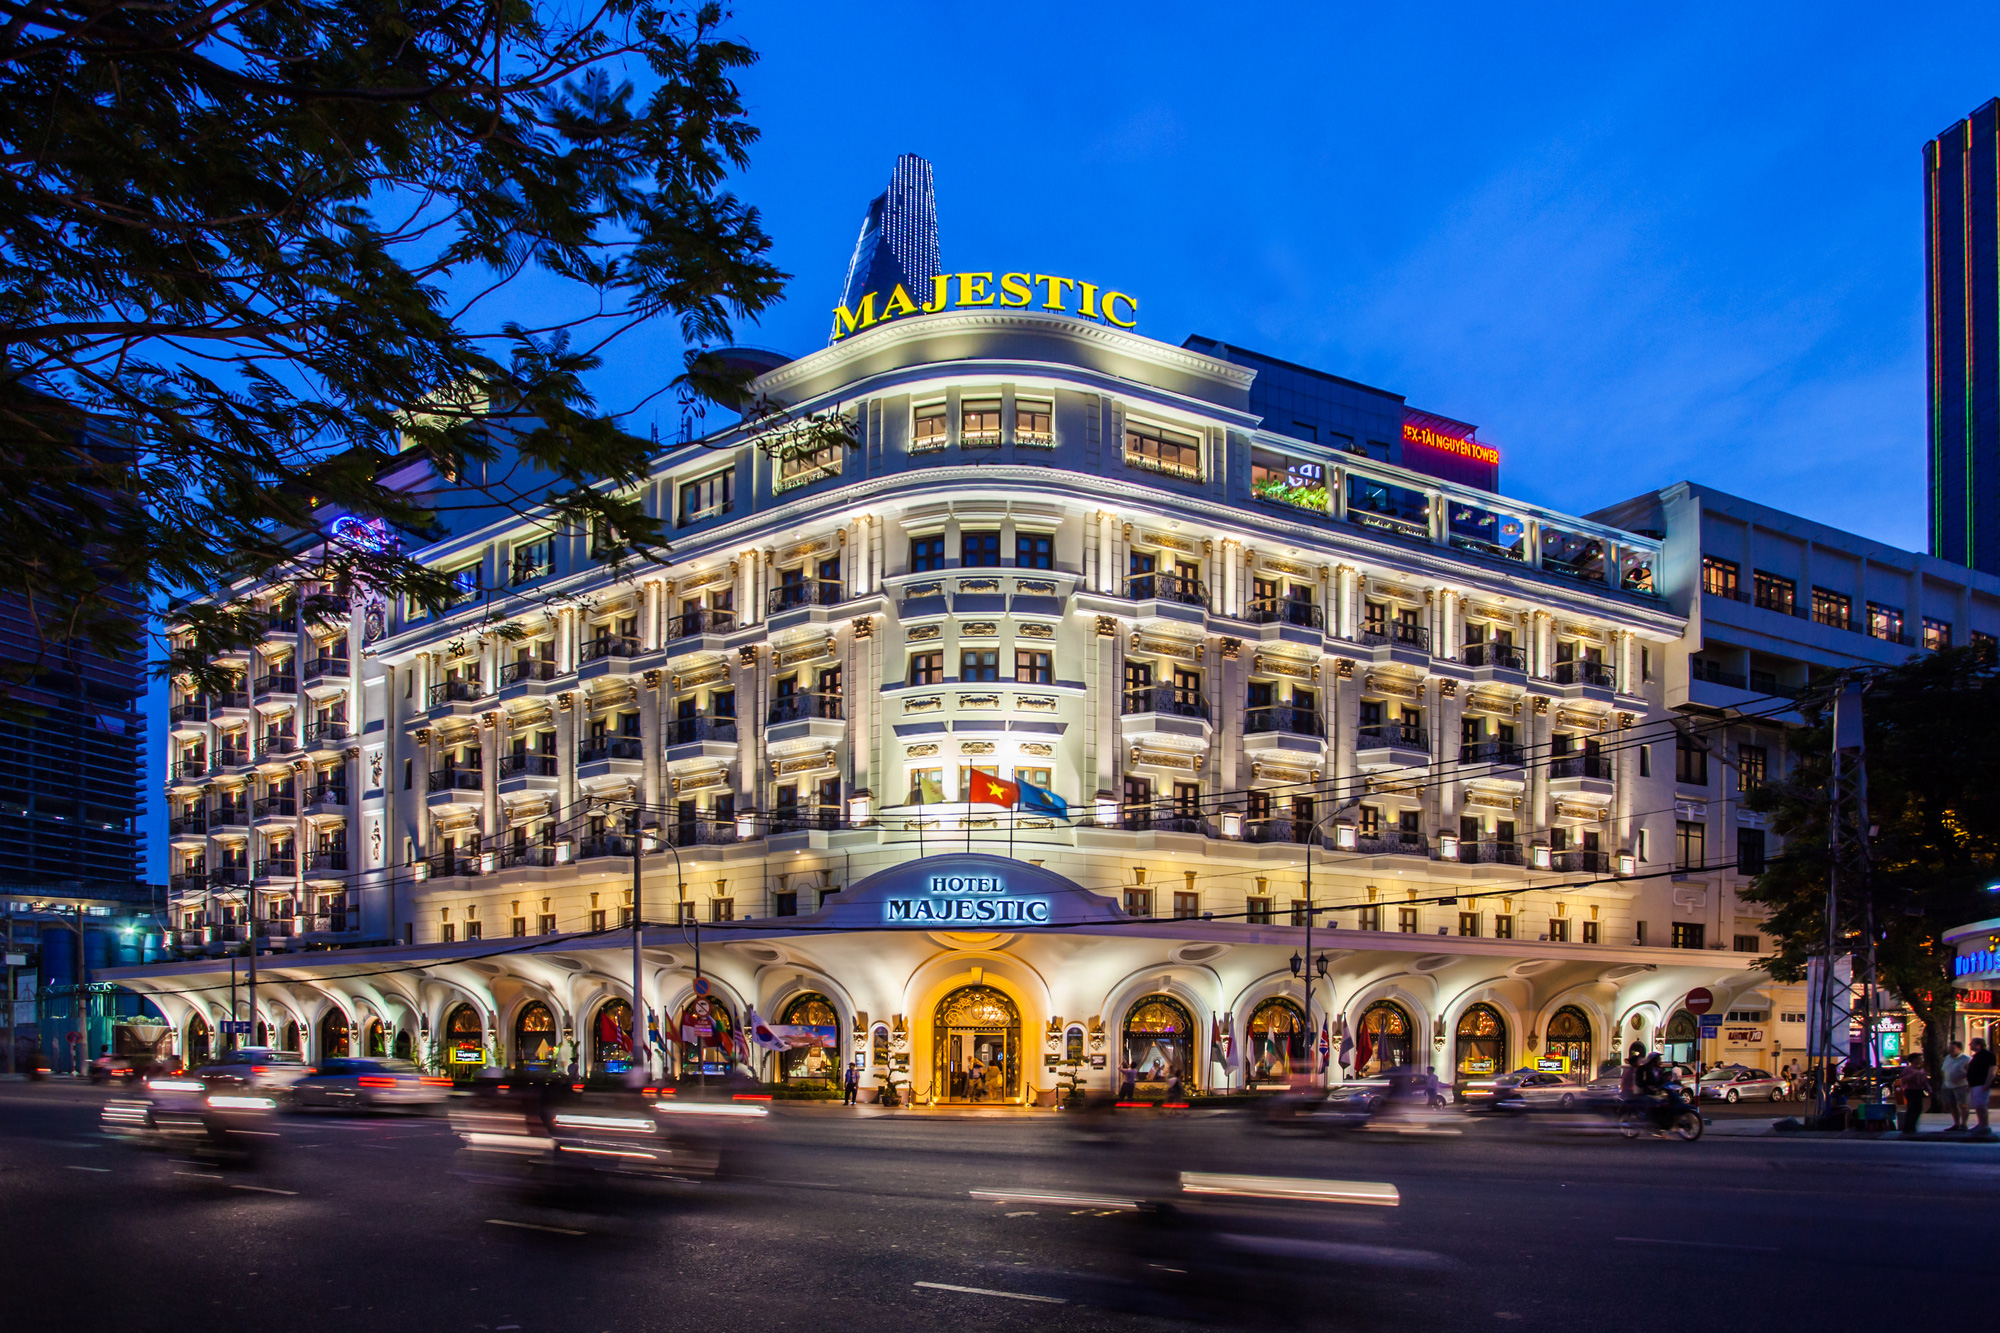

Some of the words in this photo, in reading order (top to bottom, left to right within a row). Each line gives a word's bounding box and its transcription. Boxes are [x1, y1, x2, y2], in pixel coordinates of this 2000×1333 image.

[832, 272, 1137, 340] MAJESTIC
[1472, 444, 1499, 465] TOWER
[932, 877, 1004, 892] HOTEL
[888, 899, 1049, 922] MAJESTIC
